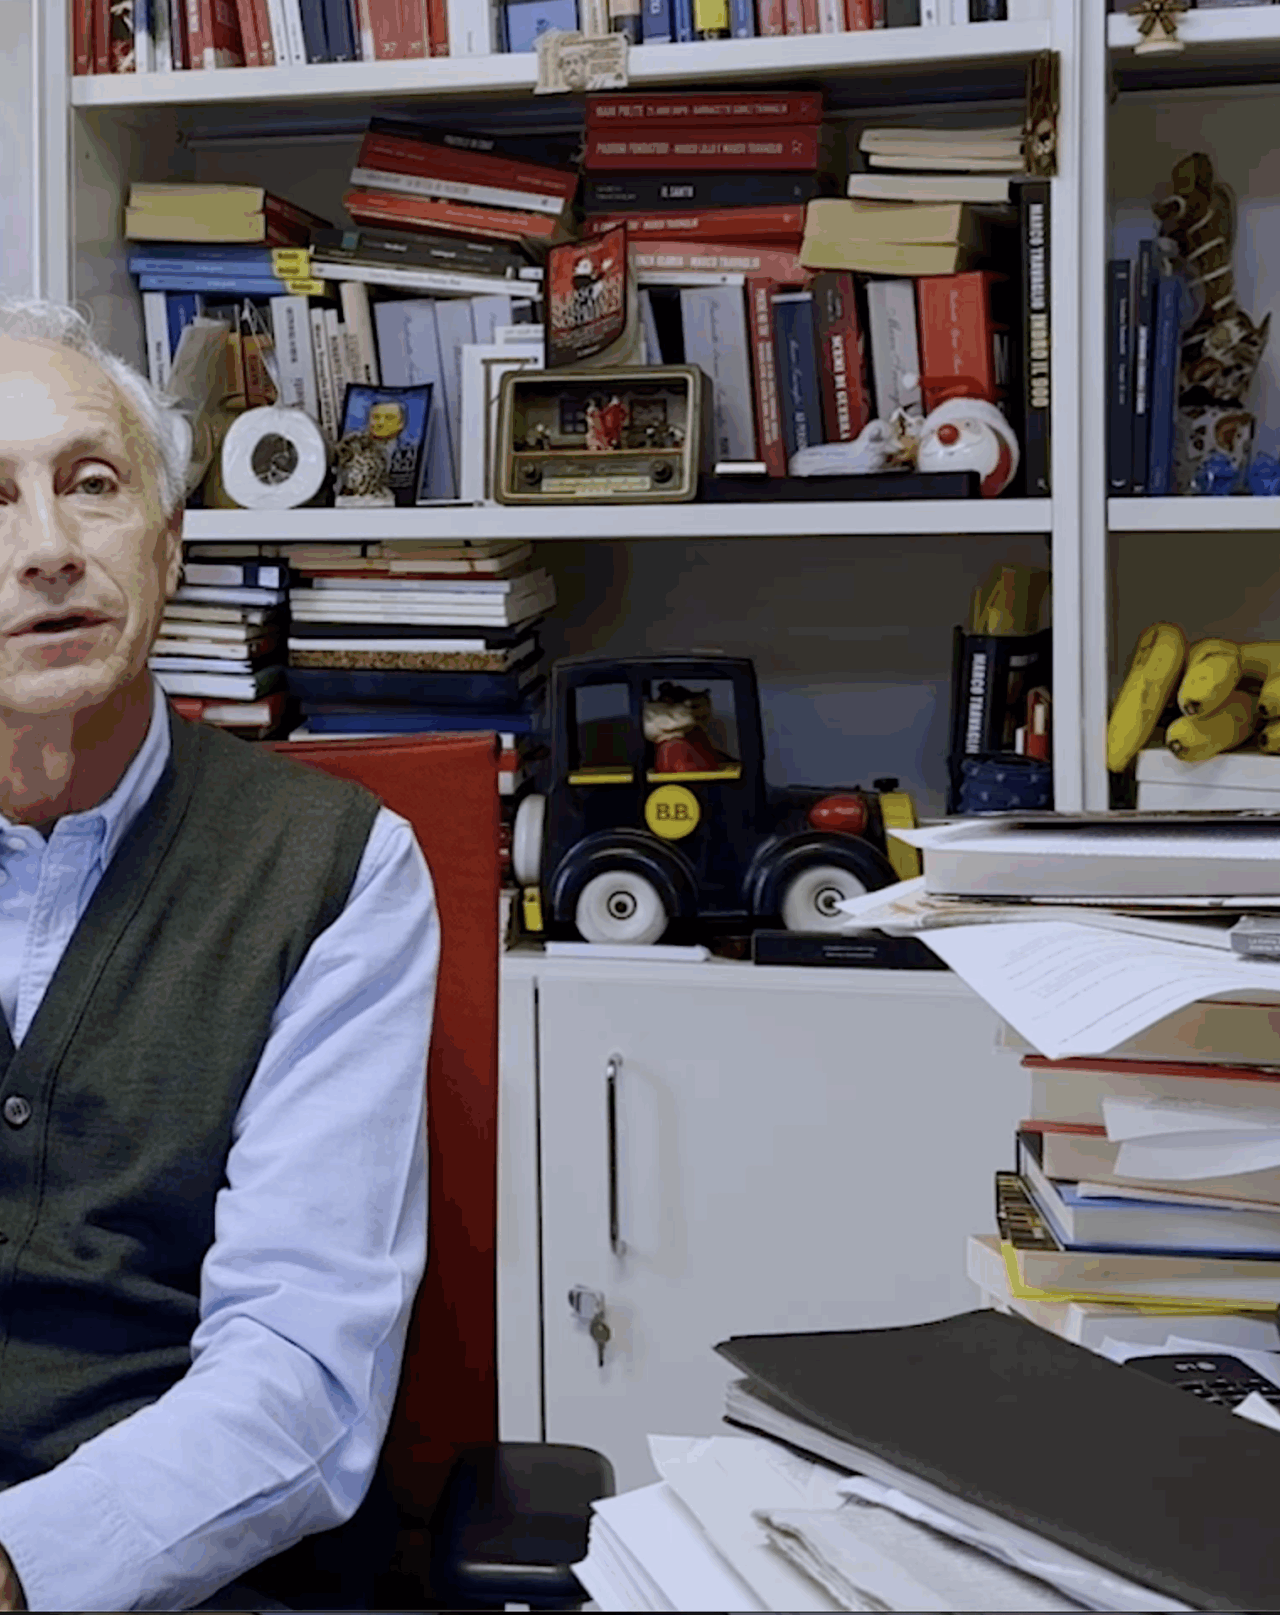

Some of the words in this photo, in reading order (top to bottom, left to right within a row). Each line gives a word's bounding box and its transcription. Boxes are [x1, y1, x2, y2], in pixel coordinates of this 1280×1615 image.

[1029, 203, 1045, 246] MARCO
[1030, 247, 1046, 310] TRAVAGLIO
[970, 653, 987, 695] MARCO
[655, 802, 693, 821] B.B.
